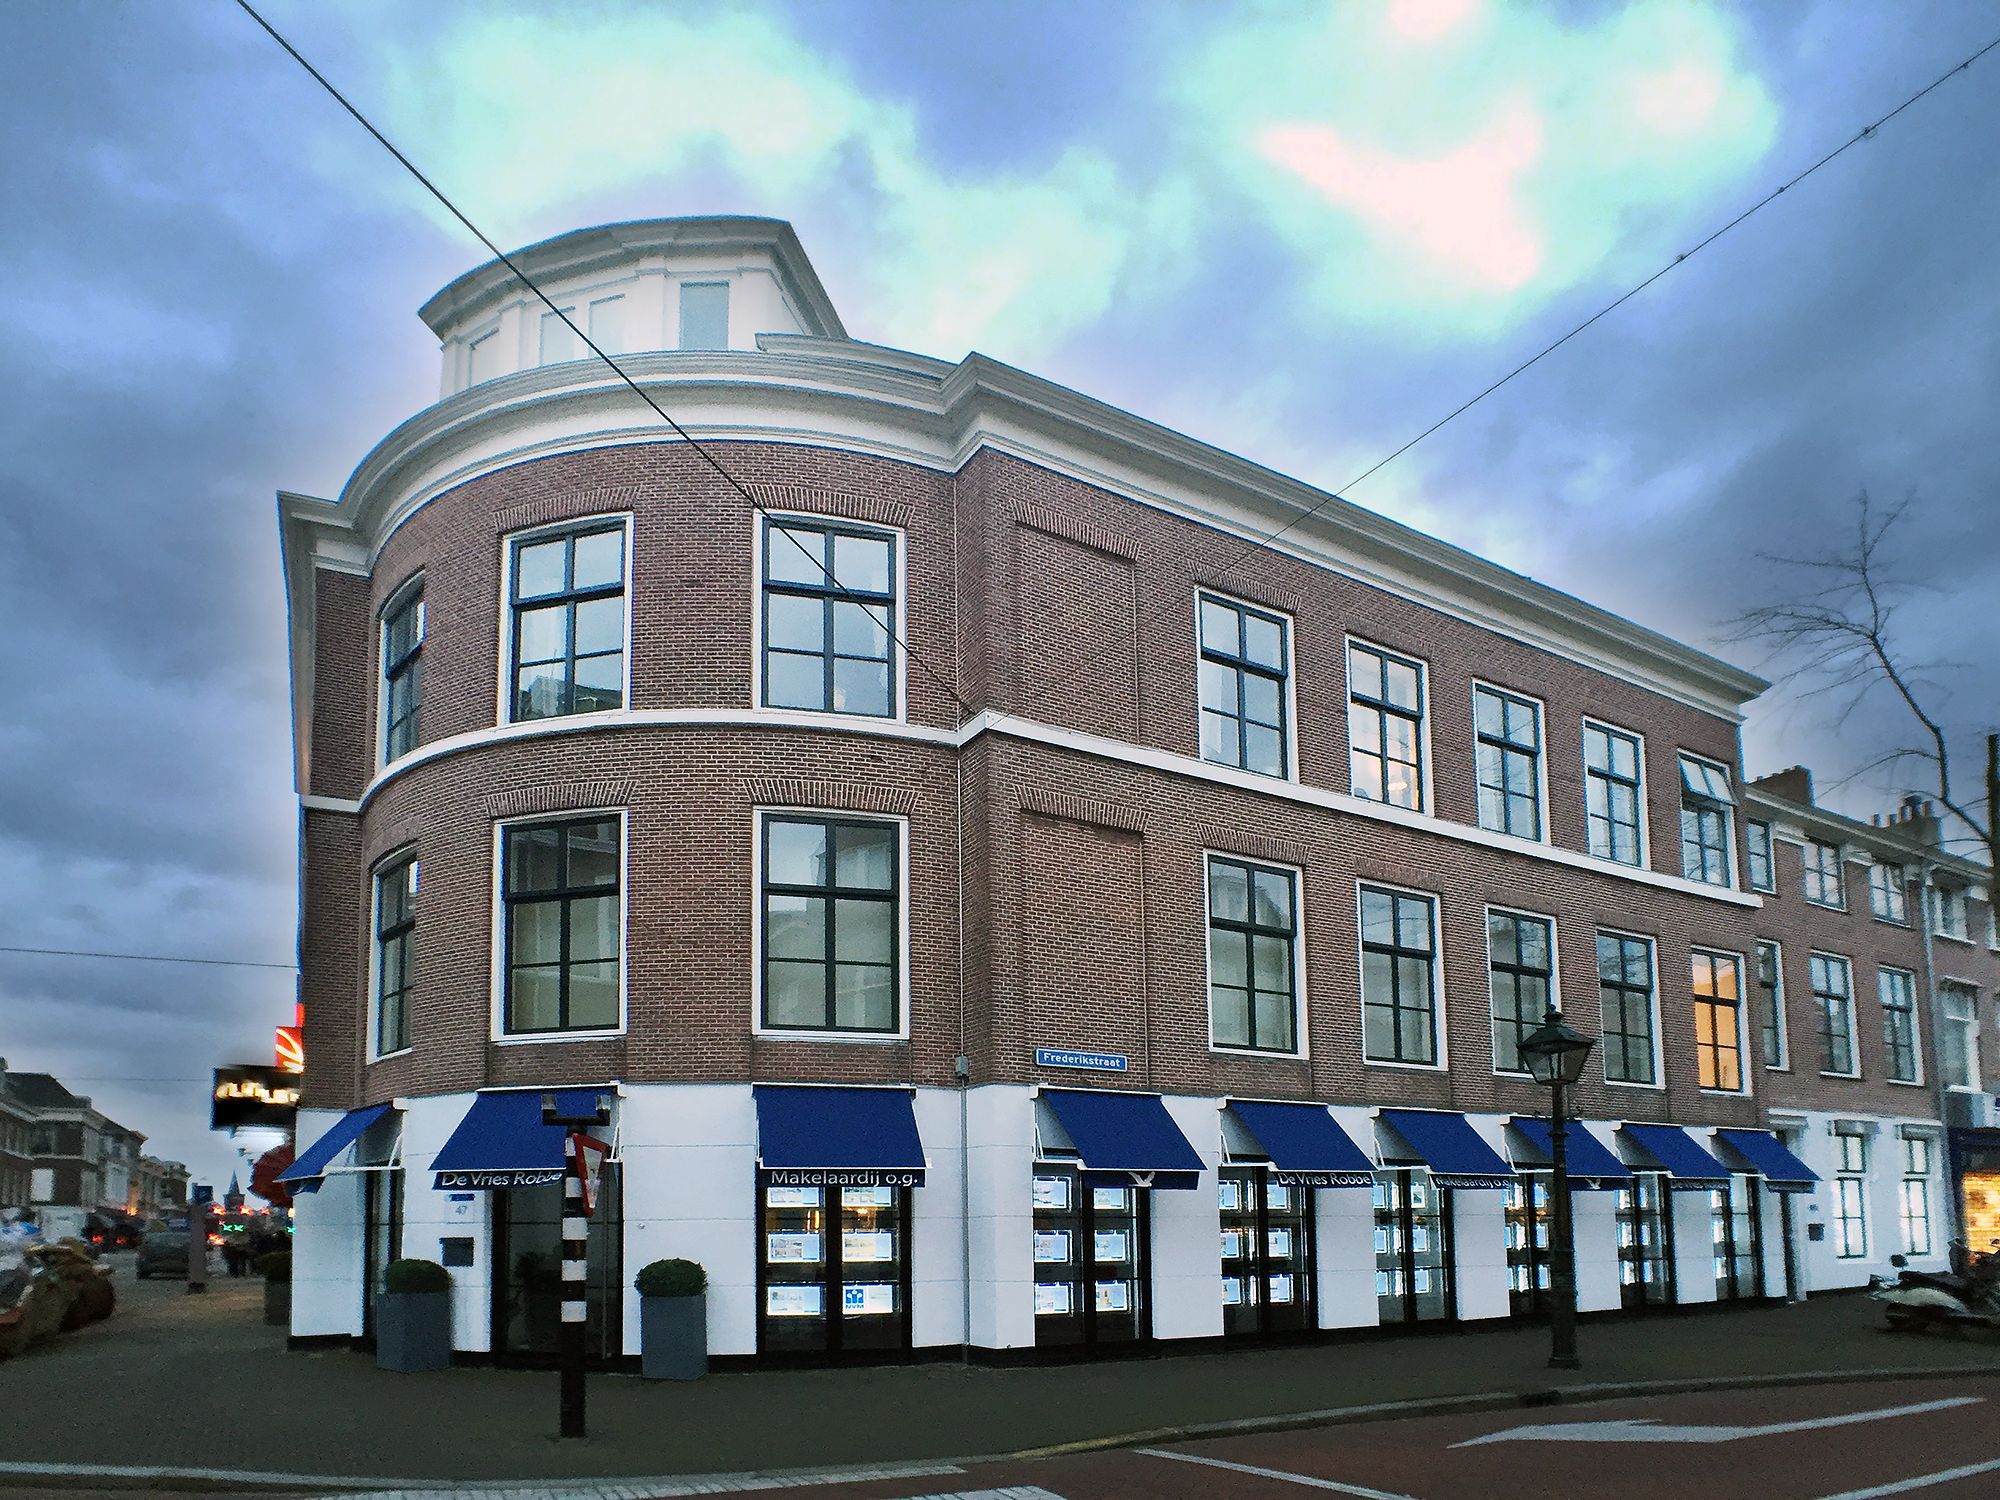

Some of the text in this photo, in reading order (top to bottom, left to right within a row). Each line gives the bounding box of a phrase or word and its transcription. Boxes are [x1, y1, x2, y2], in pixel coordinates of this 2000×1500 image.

[1043, 1052, 1121, 1067] Frederikstraat
[441, 1172, 467, 1186] De
[471, 1172, 509, 1186] Vries
[771, 1171, 918, 1187] Makelaardij o.g.
[1279, 1172, 1296, 1185] De
[1296, 1172, 1328, 1185] Vries
